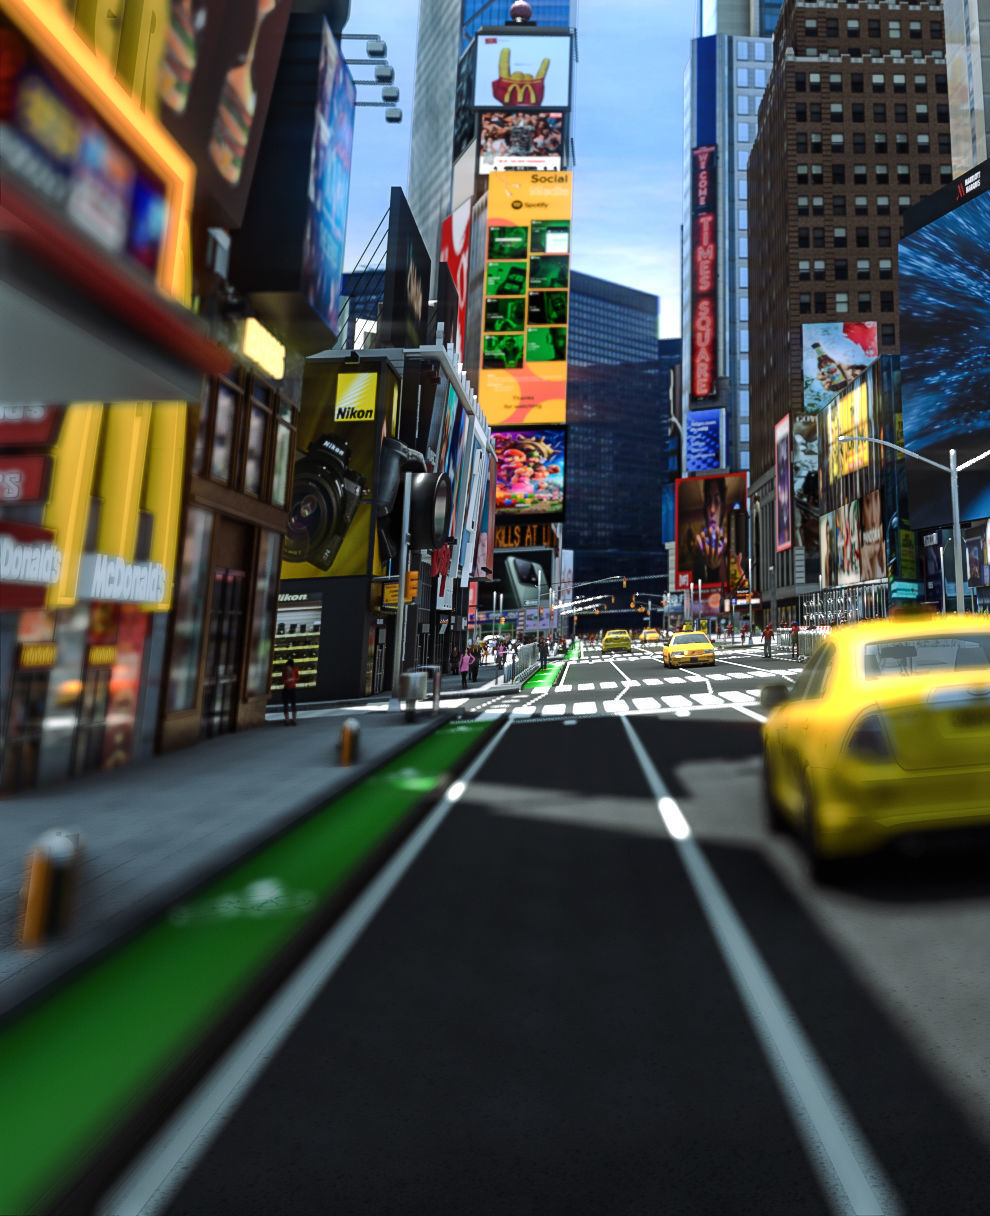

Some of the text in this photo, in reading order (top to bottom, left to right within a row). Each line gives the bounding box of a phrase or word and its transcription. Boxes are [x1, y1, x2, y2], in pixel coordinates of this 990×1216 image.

[531, 174, 568, 183] Social
[696, 216, 715, 397] TIMES SQUARE
[336, 406, 374, 420] Nikon
[322, 440, 345, 456] Nikon
[525, 524, 538, 547] AT
[90, 553, 167, 601] McDonald's
